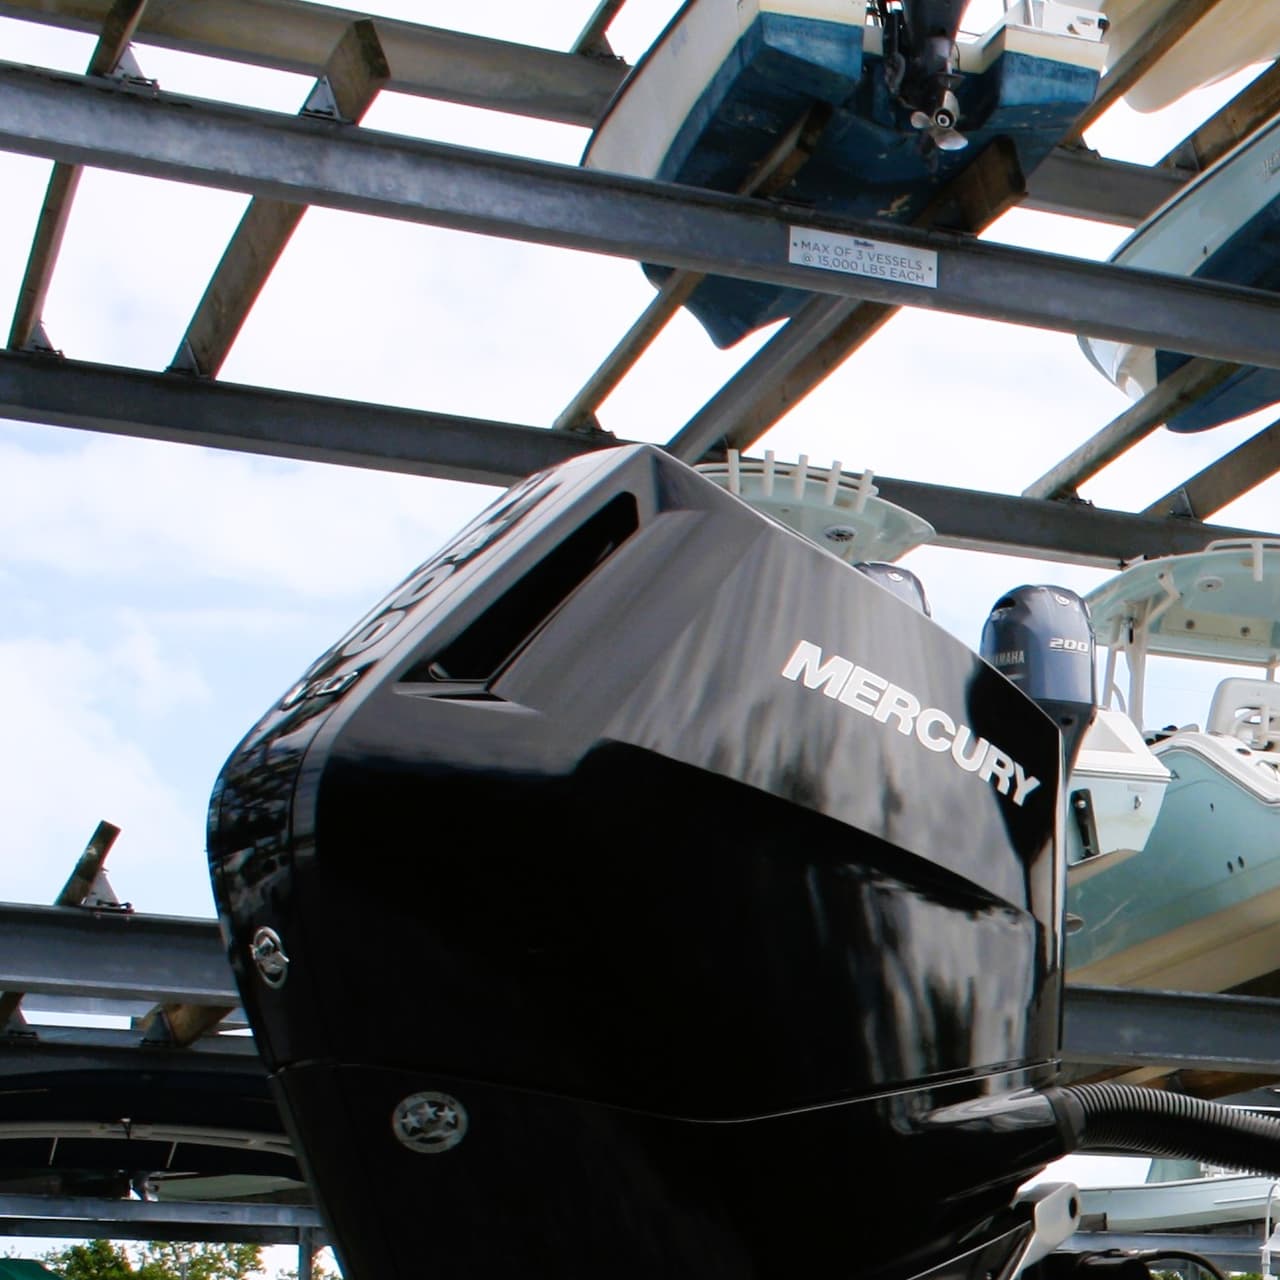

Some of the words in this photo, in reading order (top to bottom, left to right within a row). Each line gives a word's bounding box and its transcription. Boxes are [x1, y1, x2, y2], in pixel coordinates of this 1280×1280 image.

[801, 240, 830, 254] MAX
[834, 246, 851, 257] OF
[855, 249, 863, 261] 3
[867, 251, 923, 271] VESSELS
[802, 252, 814, 264] @
[818, 254, 859, 272] 15,000
[862, 263, 887, 277] LBS
[890, 267, 925, 282] EACH
[1050, 637, 1089, 653] 200
[781, 640, 1041, 807] MERCURY
